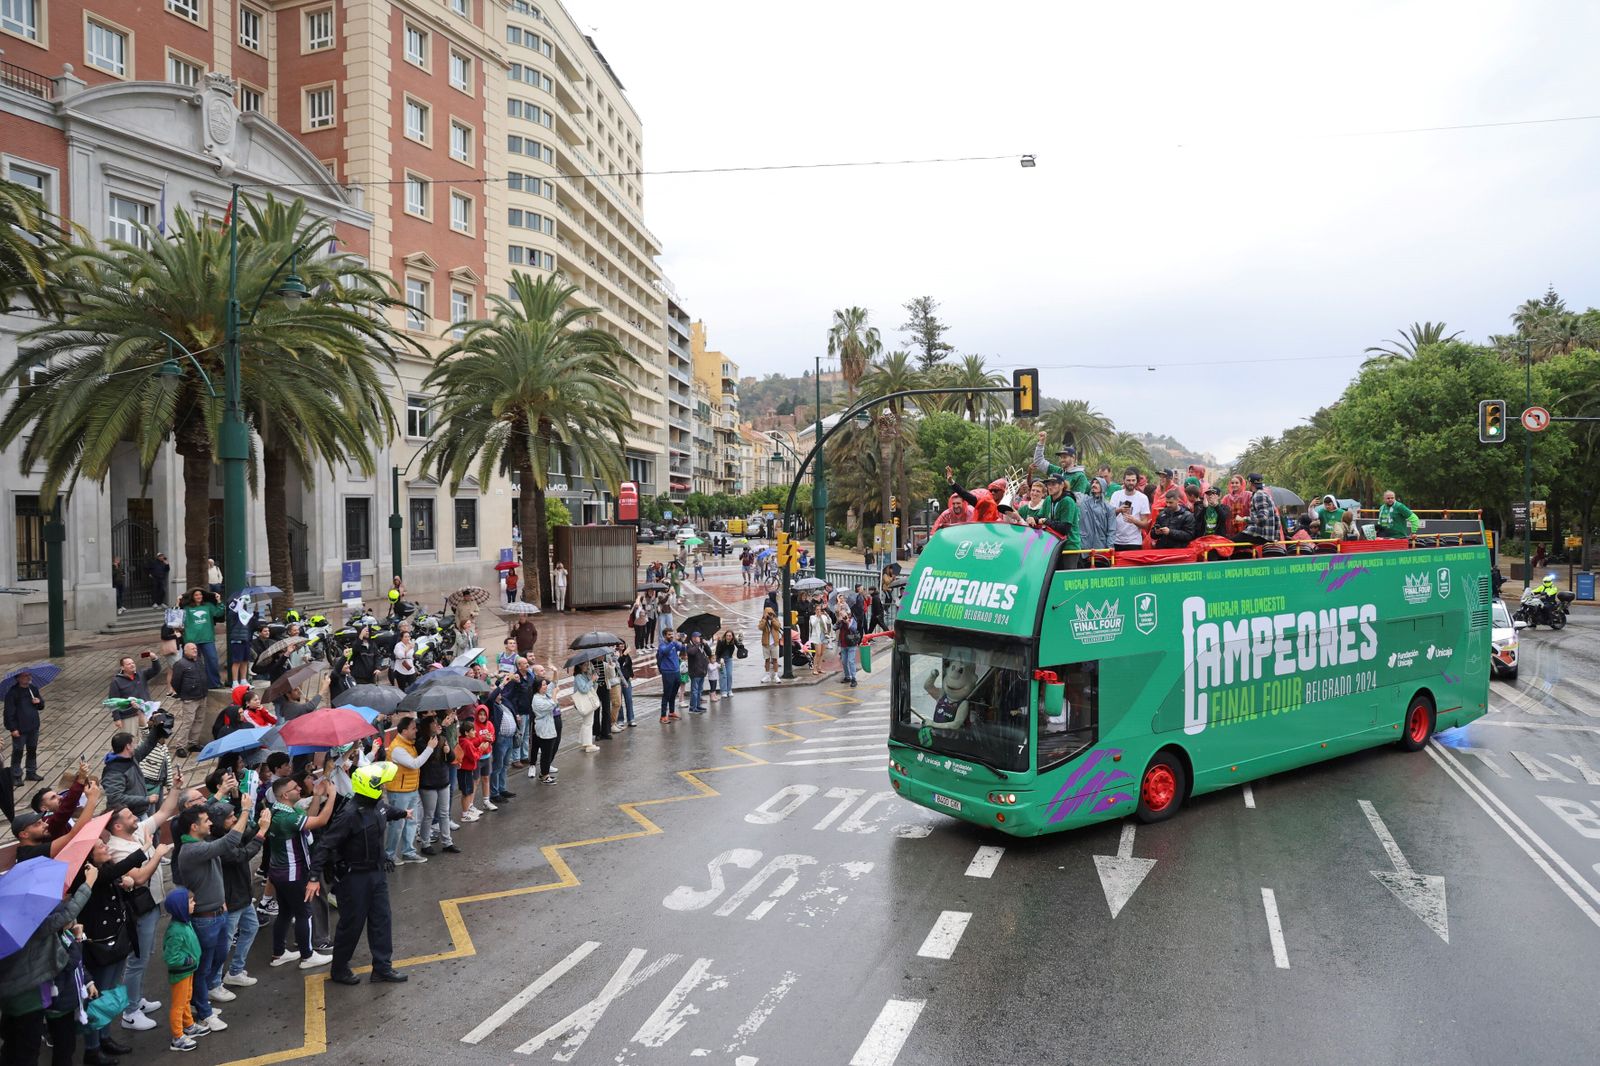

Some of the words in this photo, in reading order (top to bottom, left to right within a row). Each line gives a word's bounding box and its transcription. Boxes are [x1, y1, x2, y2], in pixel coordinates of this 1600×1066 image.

[910, 566, 1018, 615] CAMPEONES
[921, 601, 941, 617] FINAL
[942, 602, 964, 620] FOUR
[964, 609, 993, 622] BELGRADO
[993, 614, 1010, 625] 2024
[1207, 600, 1239, 618] UNICAJA
[1241, 596, 1285, 615] BALONCESTO
[1073, 620, 1098, 632] FINAL
[1100, 618, 1121, 629] FOUR
[1435, 647, 1453, 658] Unicaja
[1182, 596, 1378, 735] CAMPEONES
[1397, 658, 1413, 667] Unicaja
[1211, 684, 1258, 728] FINAL
[1261, 677, 1302, 718] FOUR
[1305, 675, 1352, 704] BELGRADO
[1356, 670, 1377, 694] 2024
[1017, 745, 1025, 755] 7
[924, 757, 940, 767] Unicaja
